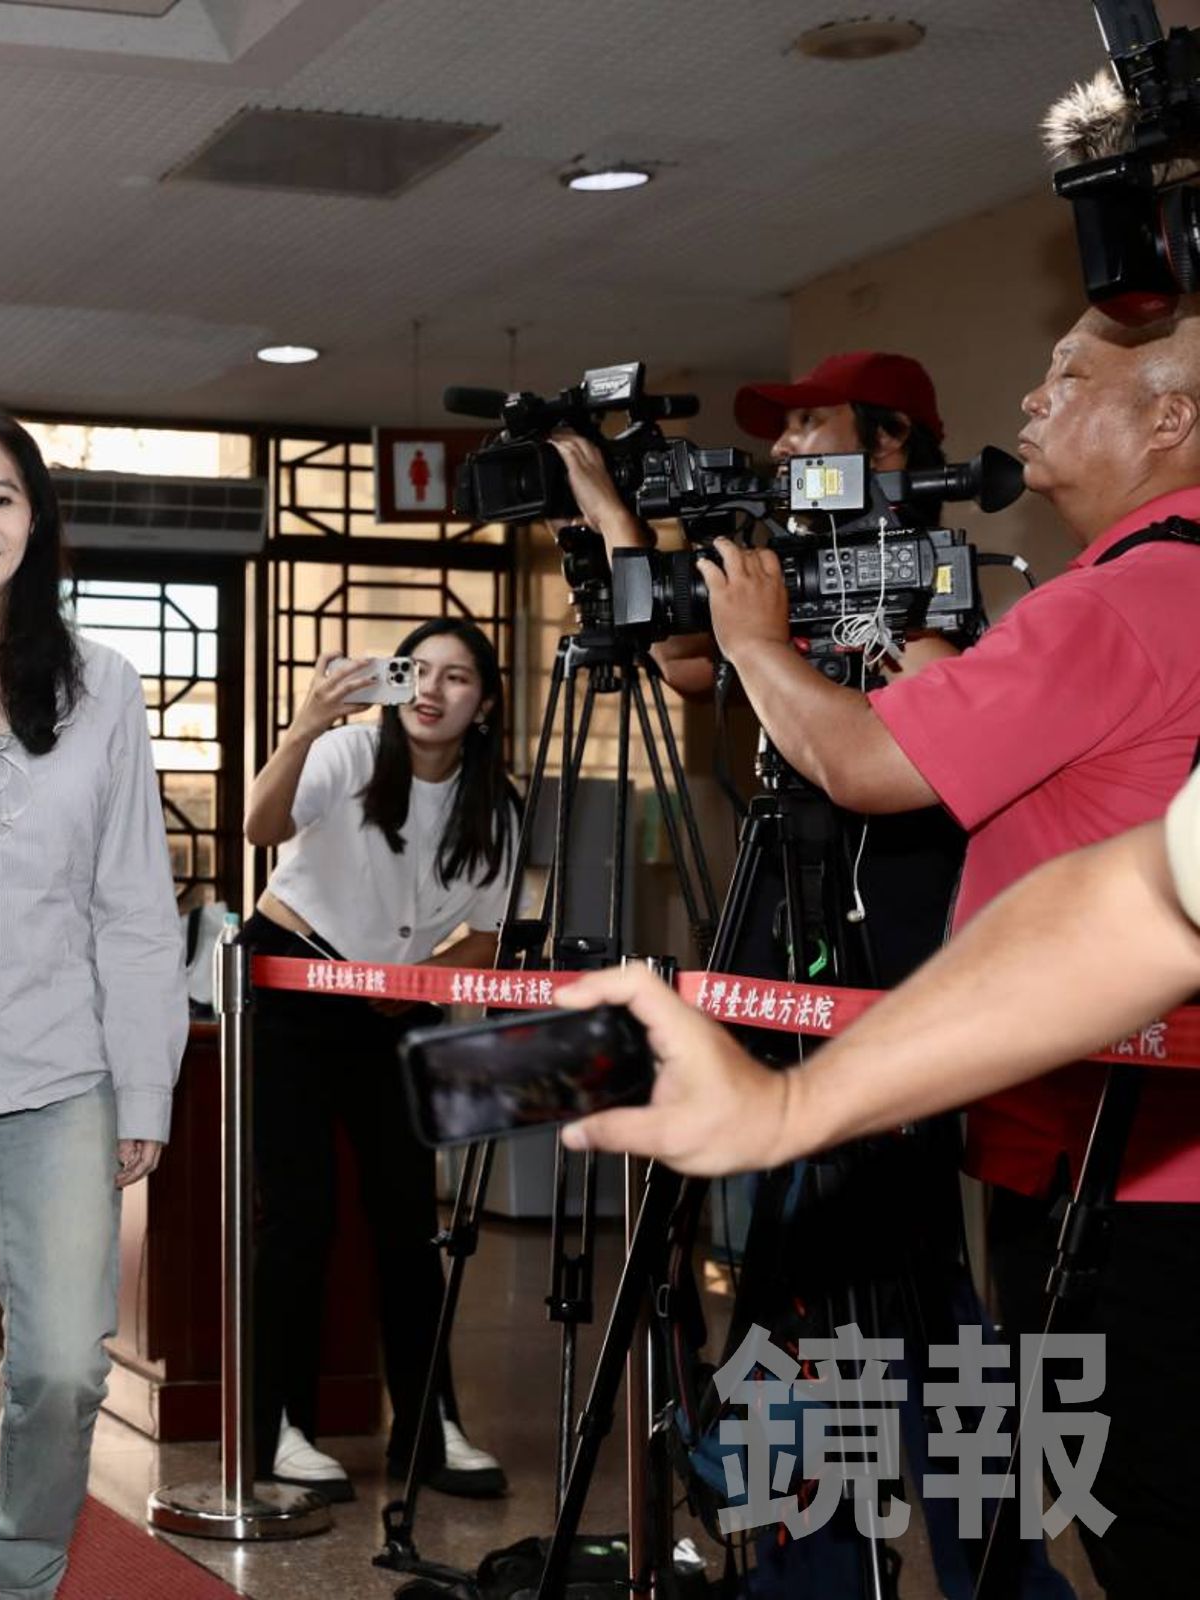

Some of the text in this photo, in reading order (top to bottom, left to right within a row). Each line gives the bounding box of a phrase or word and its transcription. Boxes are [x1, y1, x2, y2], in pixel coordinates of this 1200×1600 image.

[450, 971, 553, 1005] 臺灣臺北地方法院
